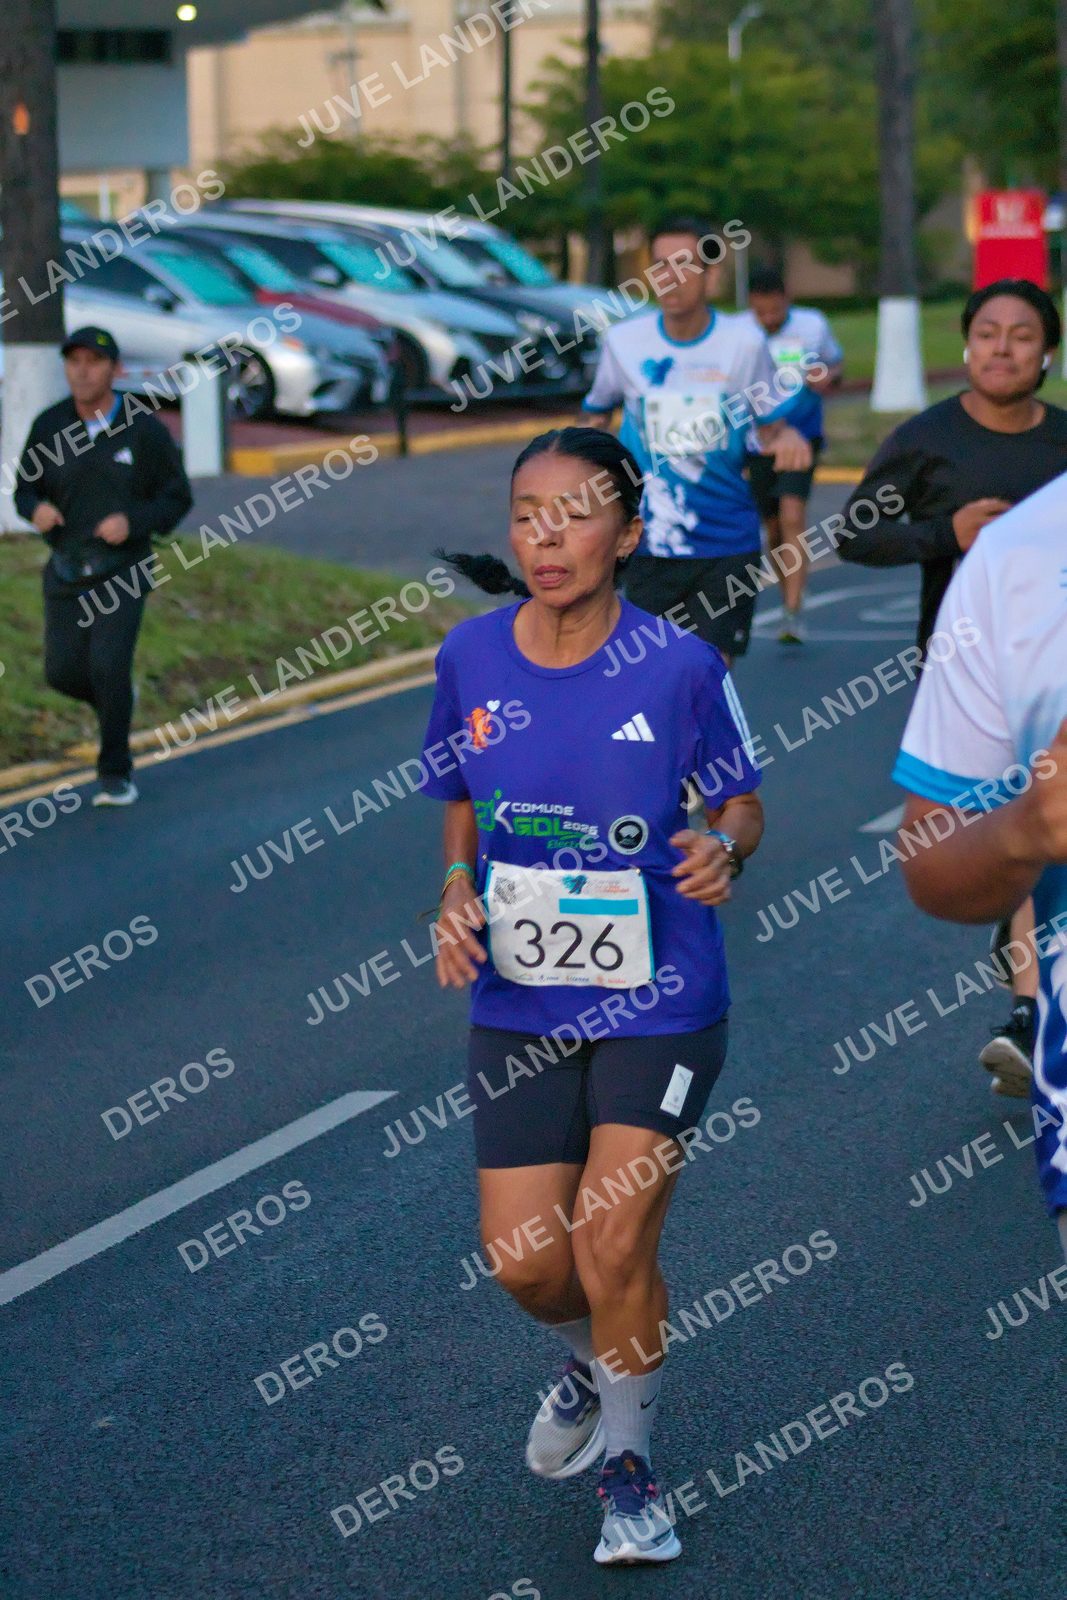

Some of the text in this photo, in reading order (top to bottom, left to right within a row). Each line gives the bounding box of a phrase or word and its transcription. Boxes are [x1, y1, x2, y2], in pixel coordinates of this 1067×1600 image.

[511, 802, 575, 816] COMUDE
[513, 816, 566, 837] GDL
[514, 918, 624, 971] 326
